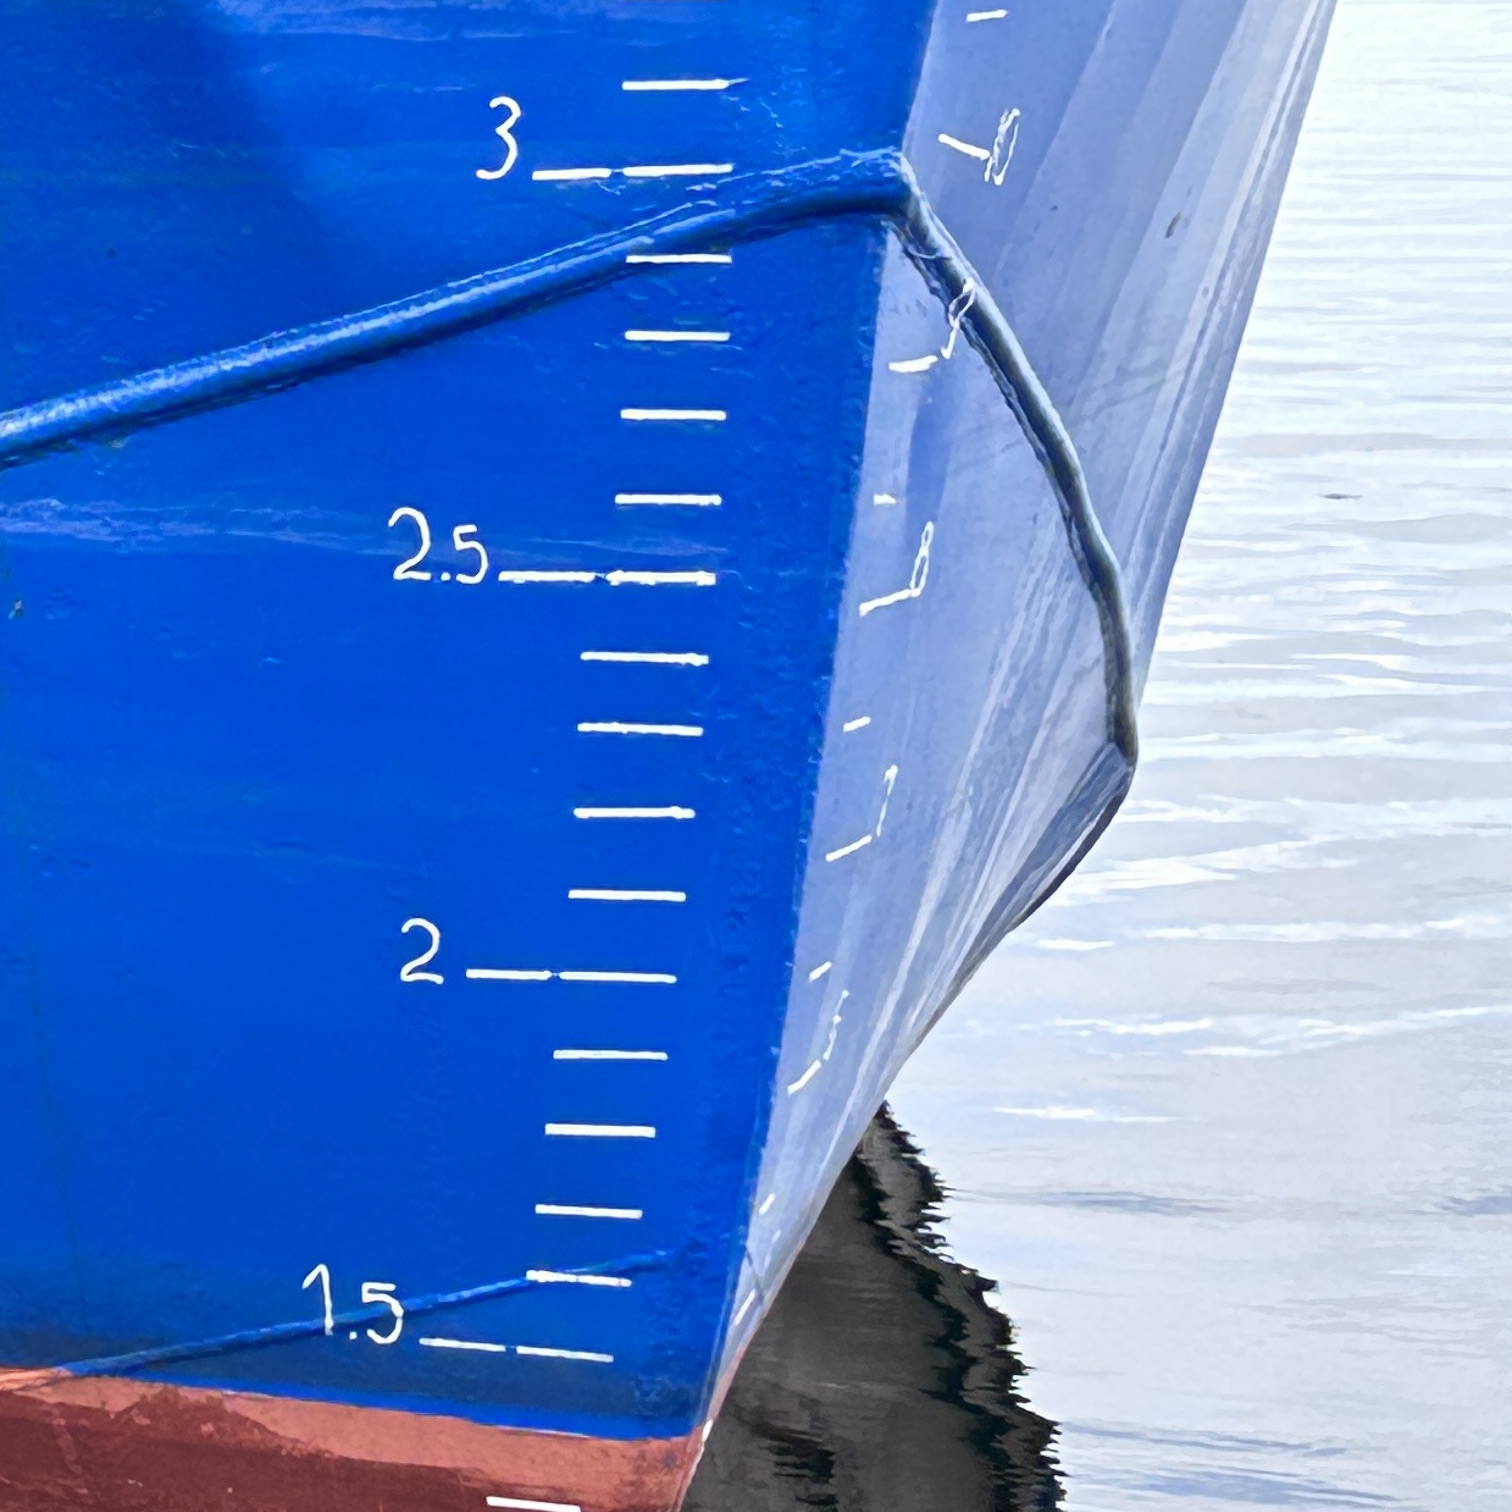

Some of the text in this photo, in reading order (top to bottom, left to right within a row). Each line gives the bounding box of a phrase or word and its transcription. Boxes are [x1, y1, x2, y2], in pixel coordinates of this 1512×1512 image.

[476, 96, 522, 180] 3
[388, 507, 489, 584] 2.5
[400, 918, 445, 985] 2
[302, 1264, 405, 1345] 1.5
